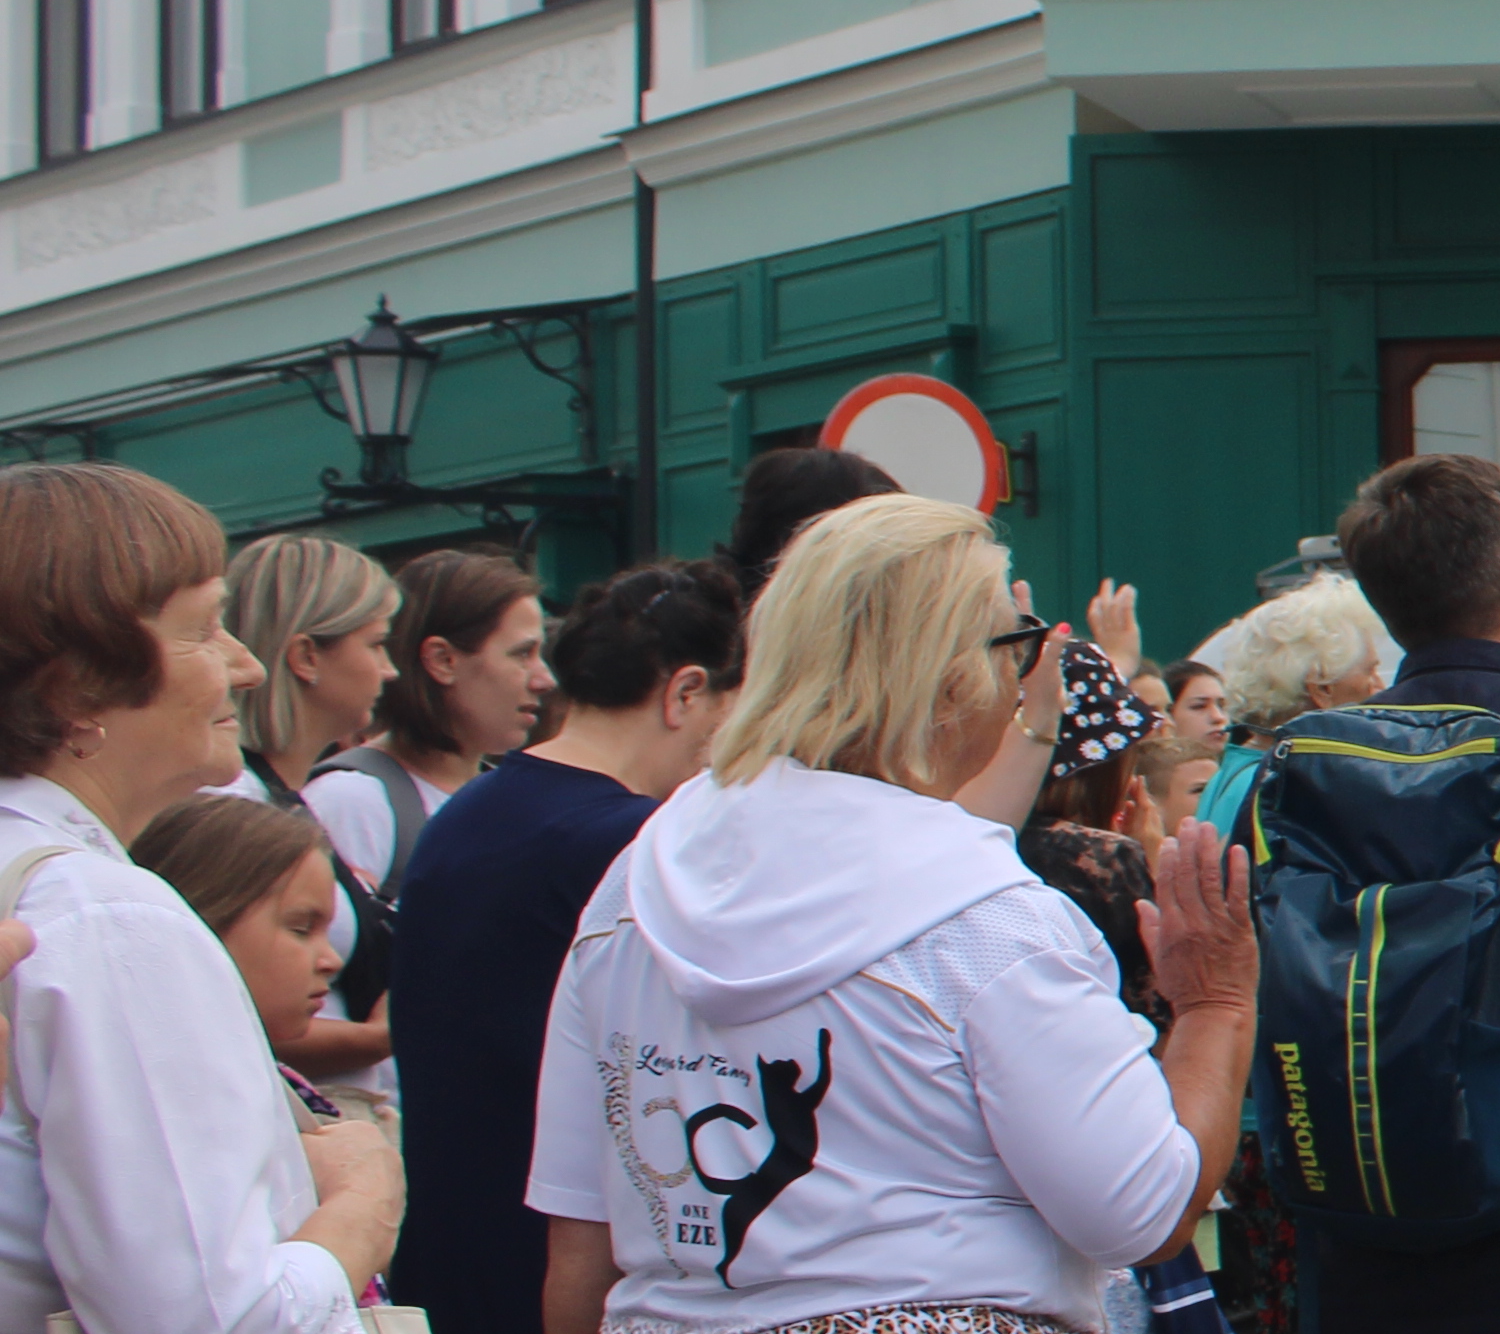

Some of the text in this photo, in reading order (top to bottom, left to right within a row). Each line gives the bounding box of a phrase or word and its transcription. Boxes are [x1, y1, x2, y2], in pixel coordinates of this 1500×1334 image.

[1273, 1042, 1327, 1192] patagonia
[682, 1204, 709, 1219] ONE
[677, 1223, 716, 1246] EZE
